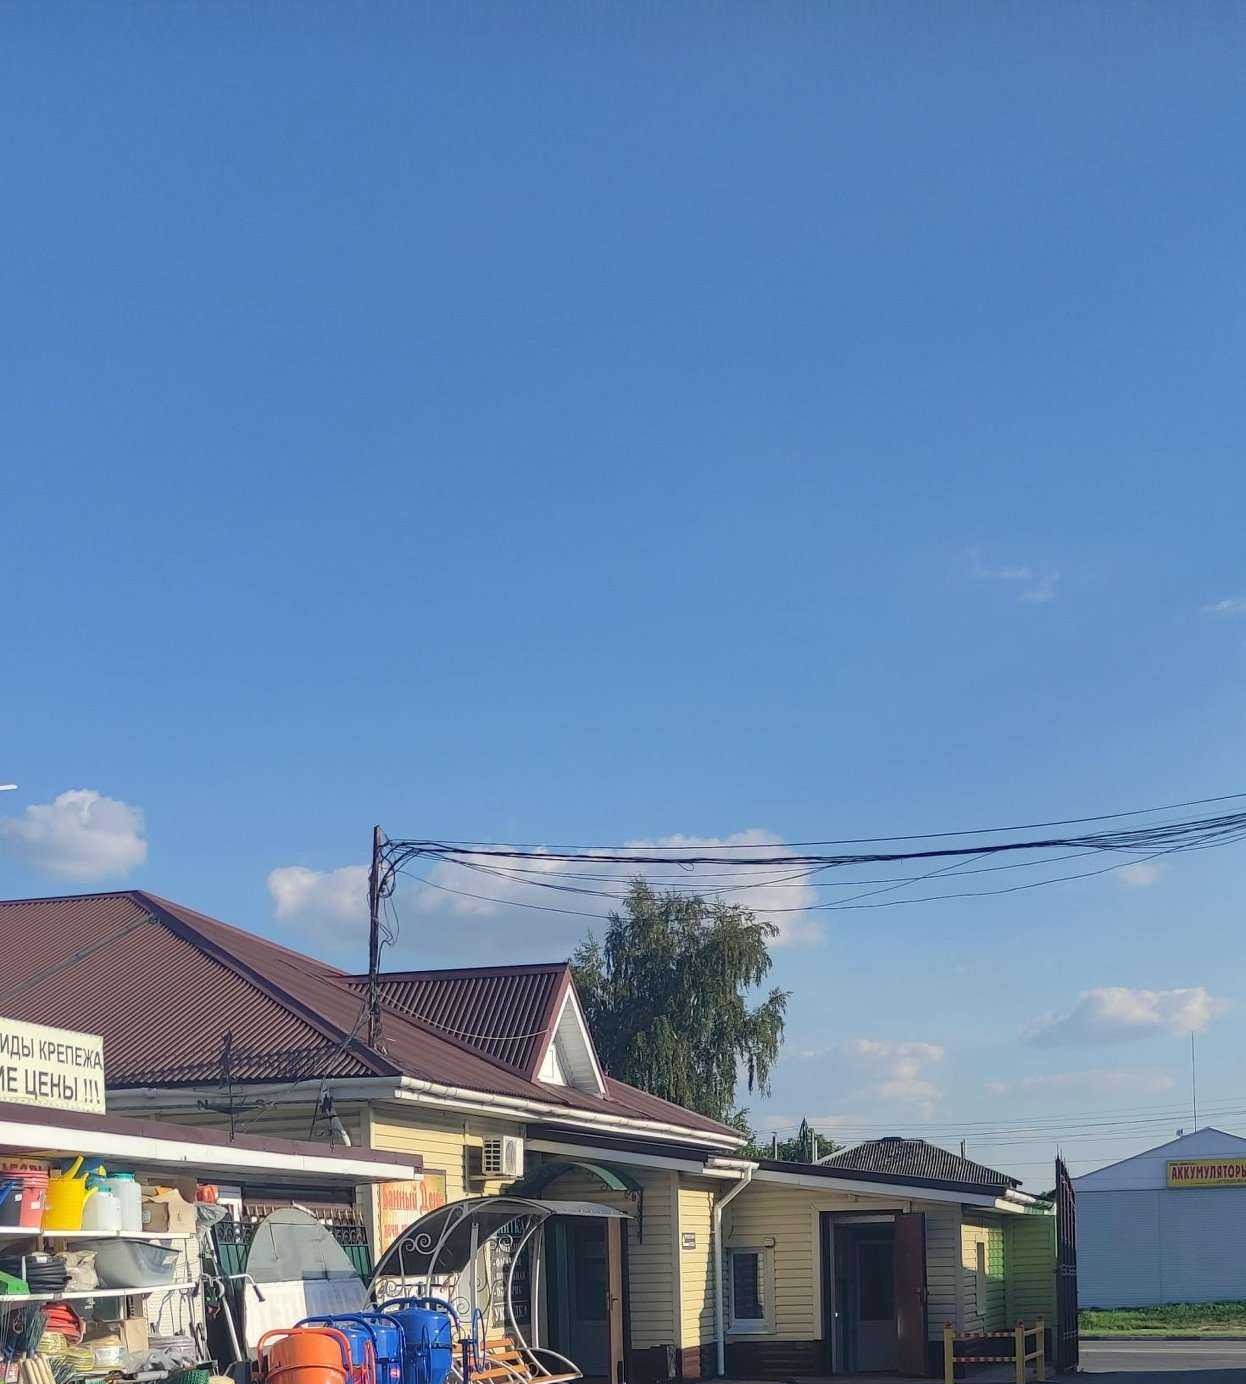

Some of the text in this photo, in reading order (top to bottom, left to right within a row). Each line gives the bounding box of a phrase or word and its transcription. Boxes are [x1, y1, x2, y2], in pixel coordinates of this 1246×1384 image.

[39, 1039, 103, 1070] КРЕПЕЖА
[25, 1069, 78, 1102] ЦЕНЫ
[84, 1078, 100, 1105] !!!
